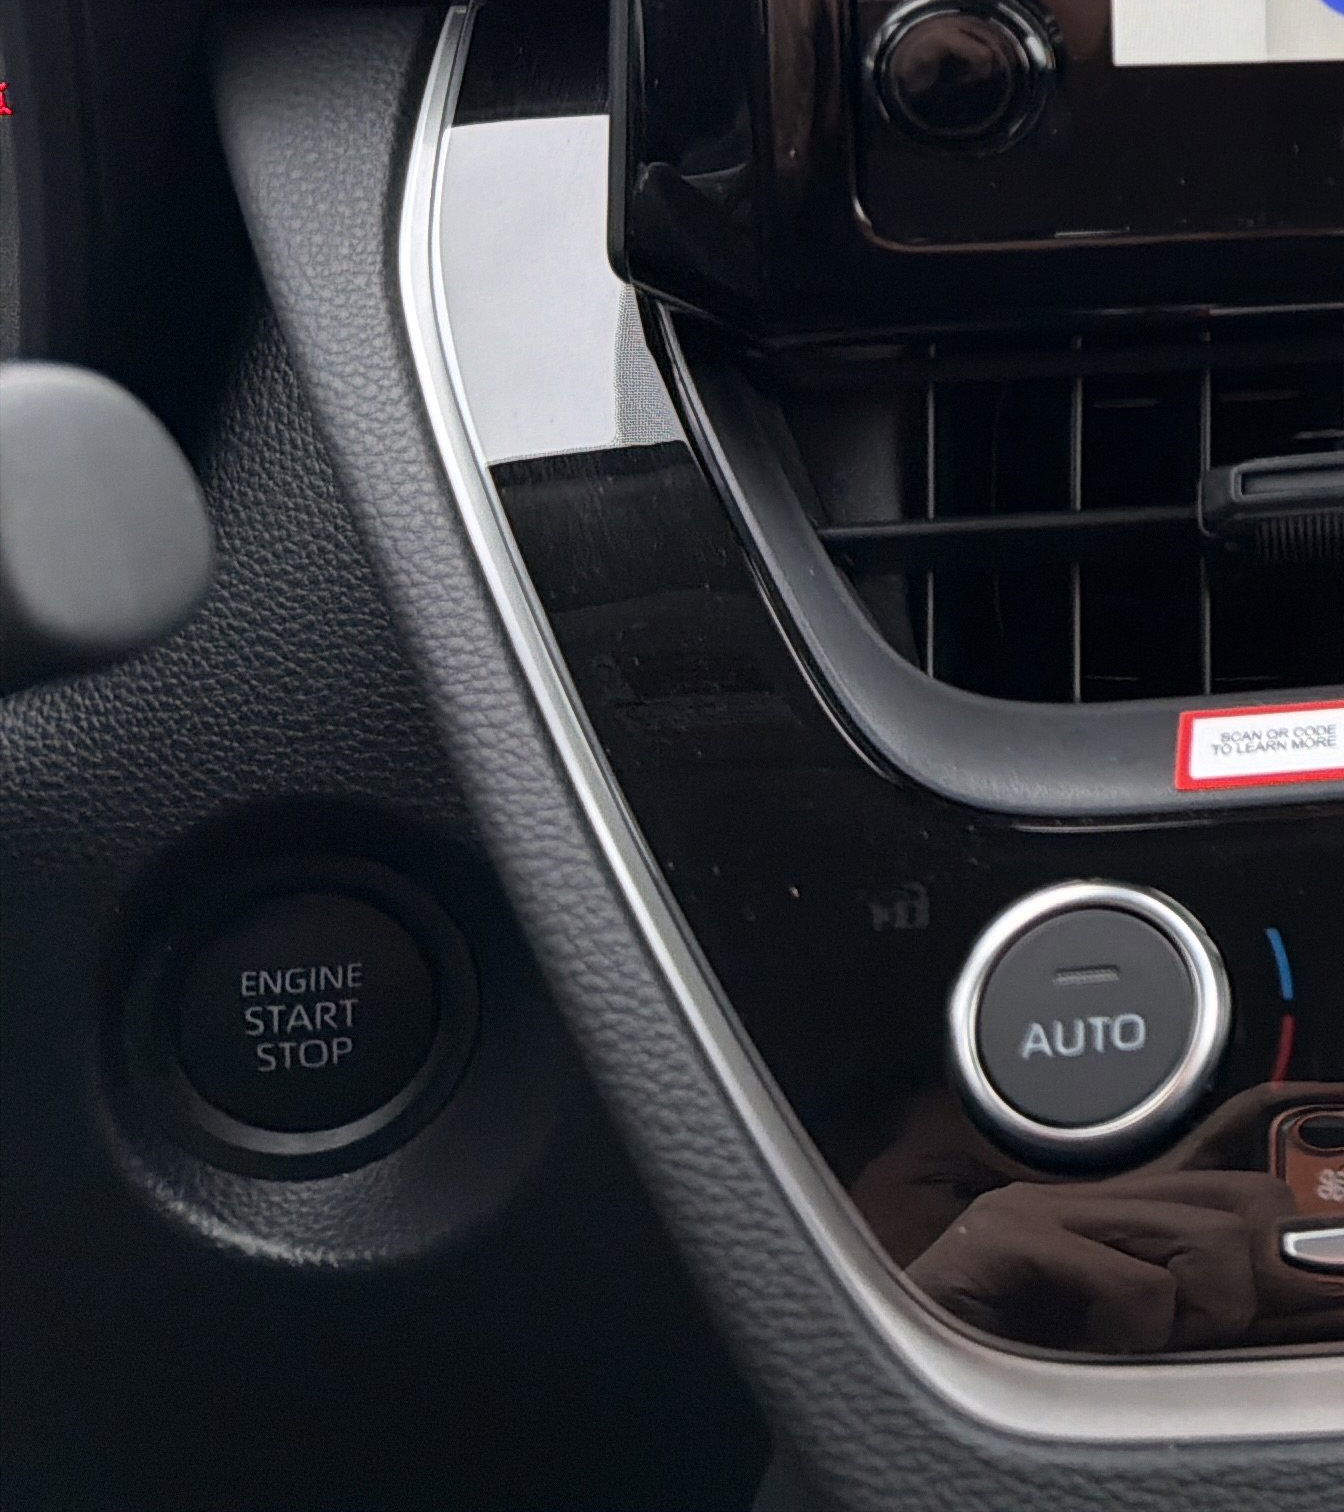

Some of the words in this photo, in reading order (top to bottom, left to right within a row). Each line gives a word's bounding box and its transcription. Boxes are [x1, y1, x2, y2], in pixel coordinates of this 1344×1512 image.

[1210, 743, 1233, 757] TO
[1236, 739, 1288, 755] LEARN
[1291, 736, 1337, 750] MORE
[1220, 730, 1263, 744] SCAN
[1292, 724, 1337, 738] CODE
[240, 962, 364, 999] ENGINE
[244, 998, 360, 1037] START
[1020, 1013, 1147, 1060] AUTO
[256, 1037, 353, 1073] STOP
